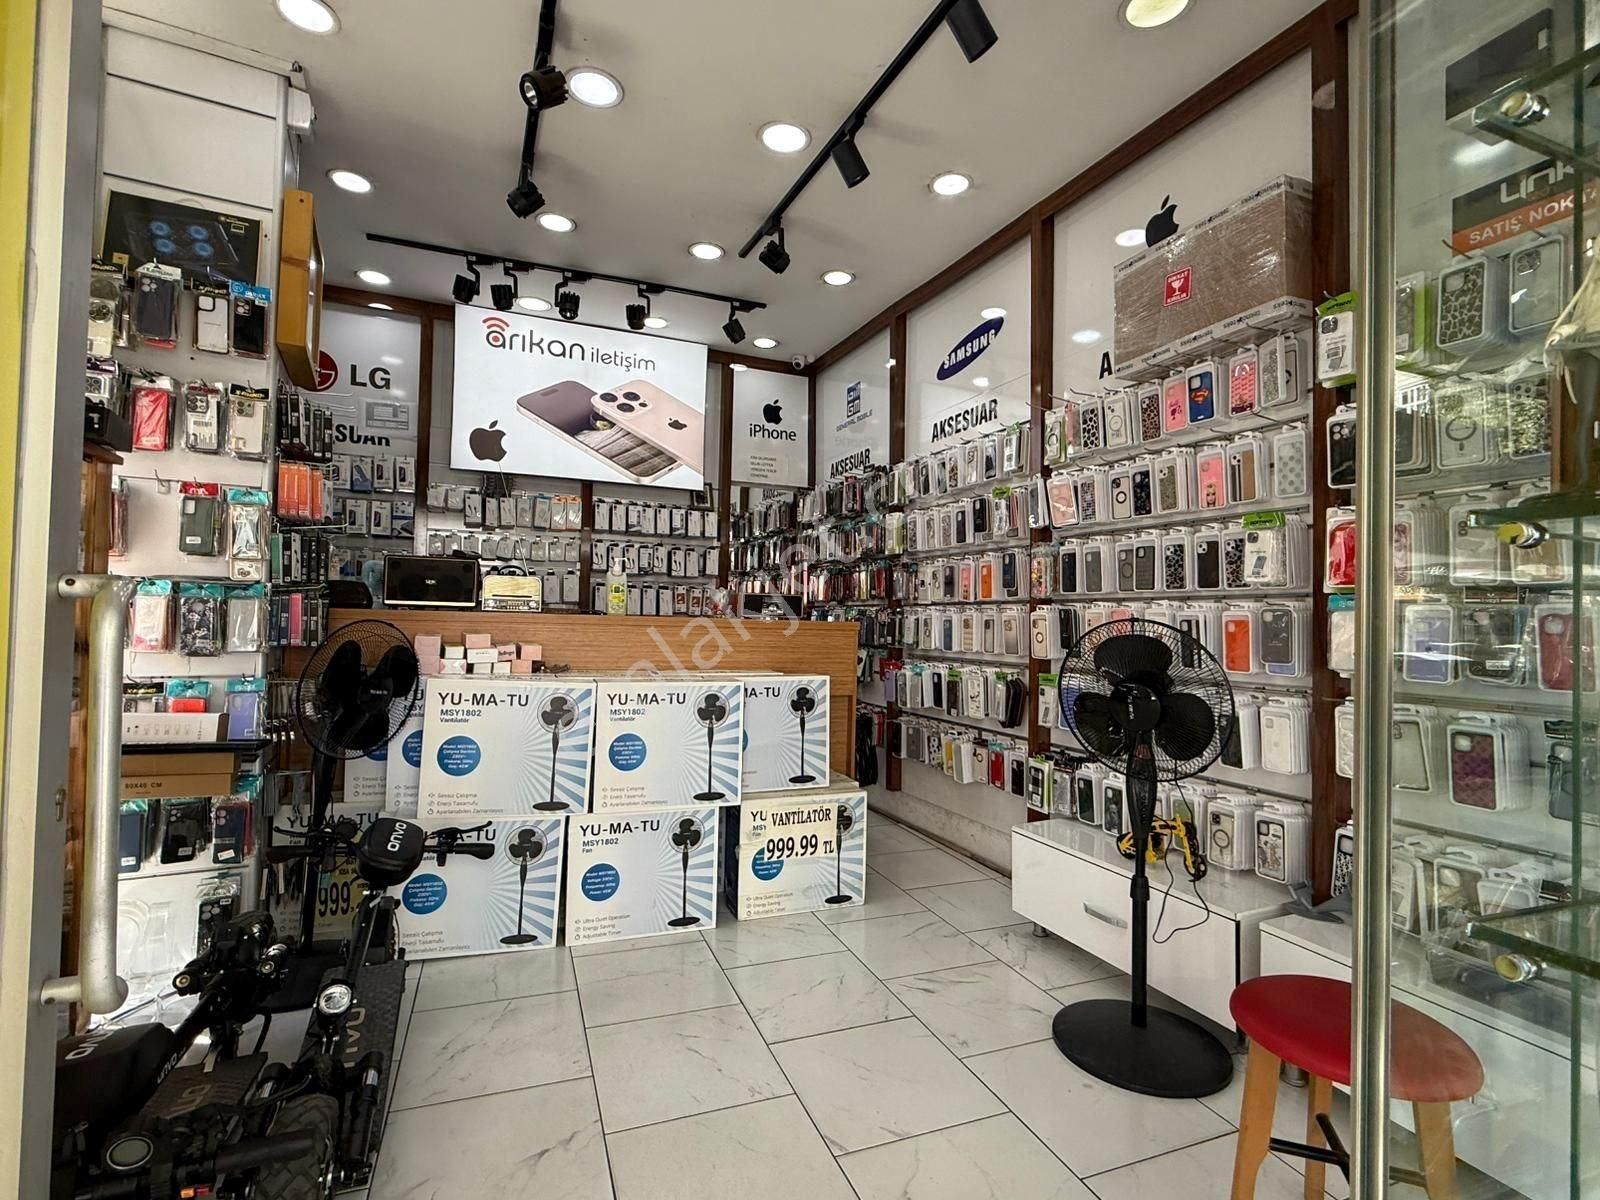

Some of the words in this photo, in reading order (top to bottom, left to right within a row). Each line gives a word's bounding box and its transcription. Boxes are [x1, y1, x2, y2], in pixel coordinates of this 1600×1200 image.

[943, 327, 997, 371] SAMSUNG
[590, 346, 656, 373] iletişim
[350, 363, 391, 390] LG
[930, 398, 999, 444] AKSESUAR
[749, 423, 797, 442] iPhone
[830, 447, 871, 480] AKSESUAR
[437, 692, 530, 707] YU-MA-TU
[607, 692, 687, 706] YU-MA-TU
[440, 708, 482, 717] MSY1802
[609, 708, 646, 716] MSY1802
[771, 805, 832, 827] VANTİLATÖR
[580, 819, 661, 837] YU-MA-TU
[582, 838, 619, 848] MSY1802
[766, 833, 819, 861] 999.99
[822, 840, 835, 855] TL
